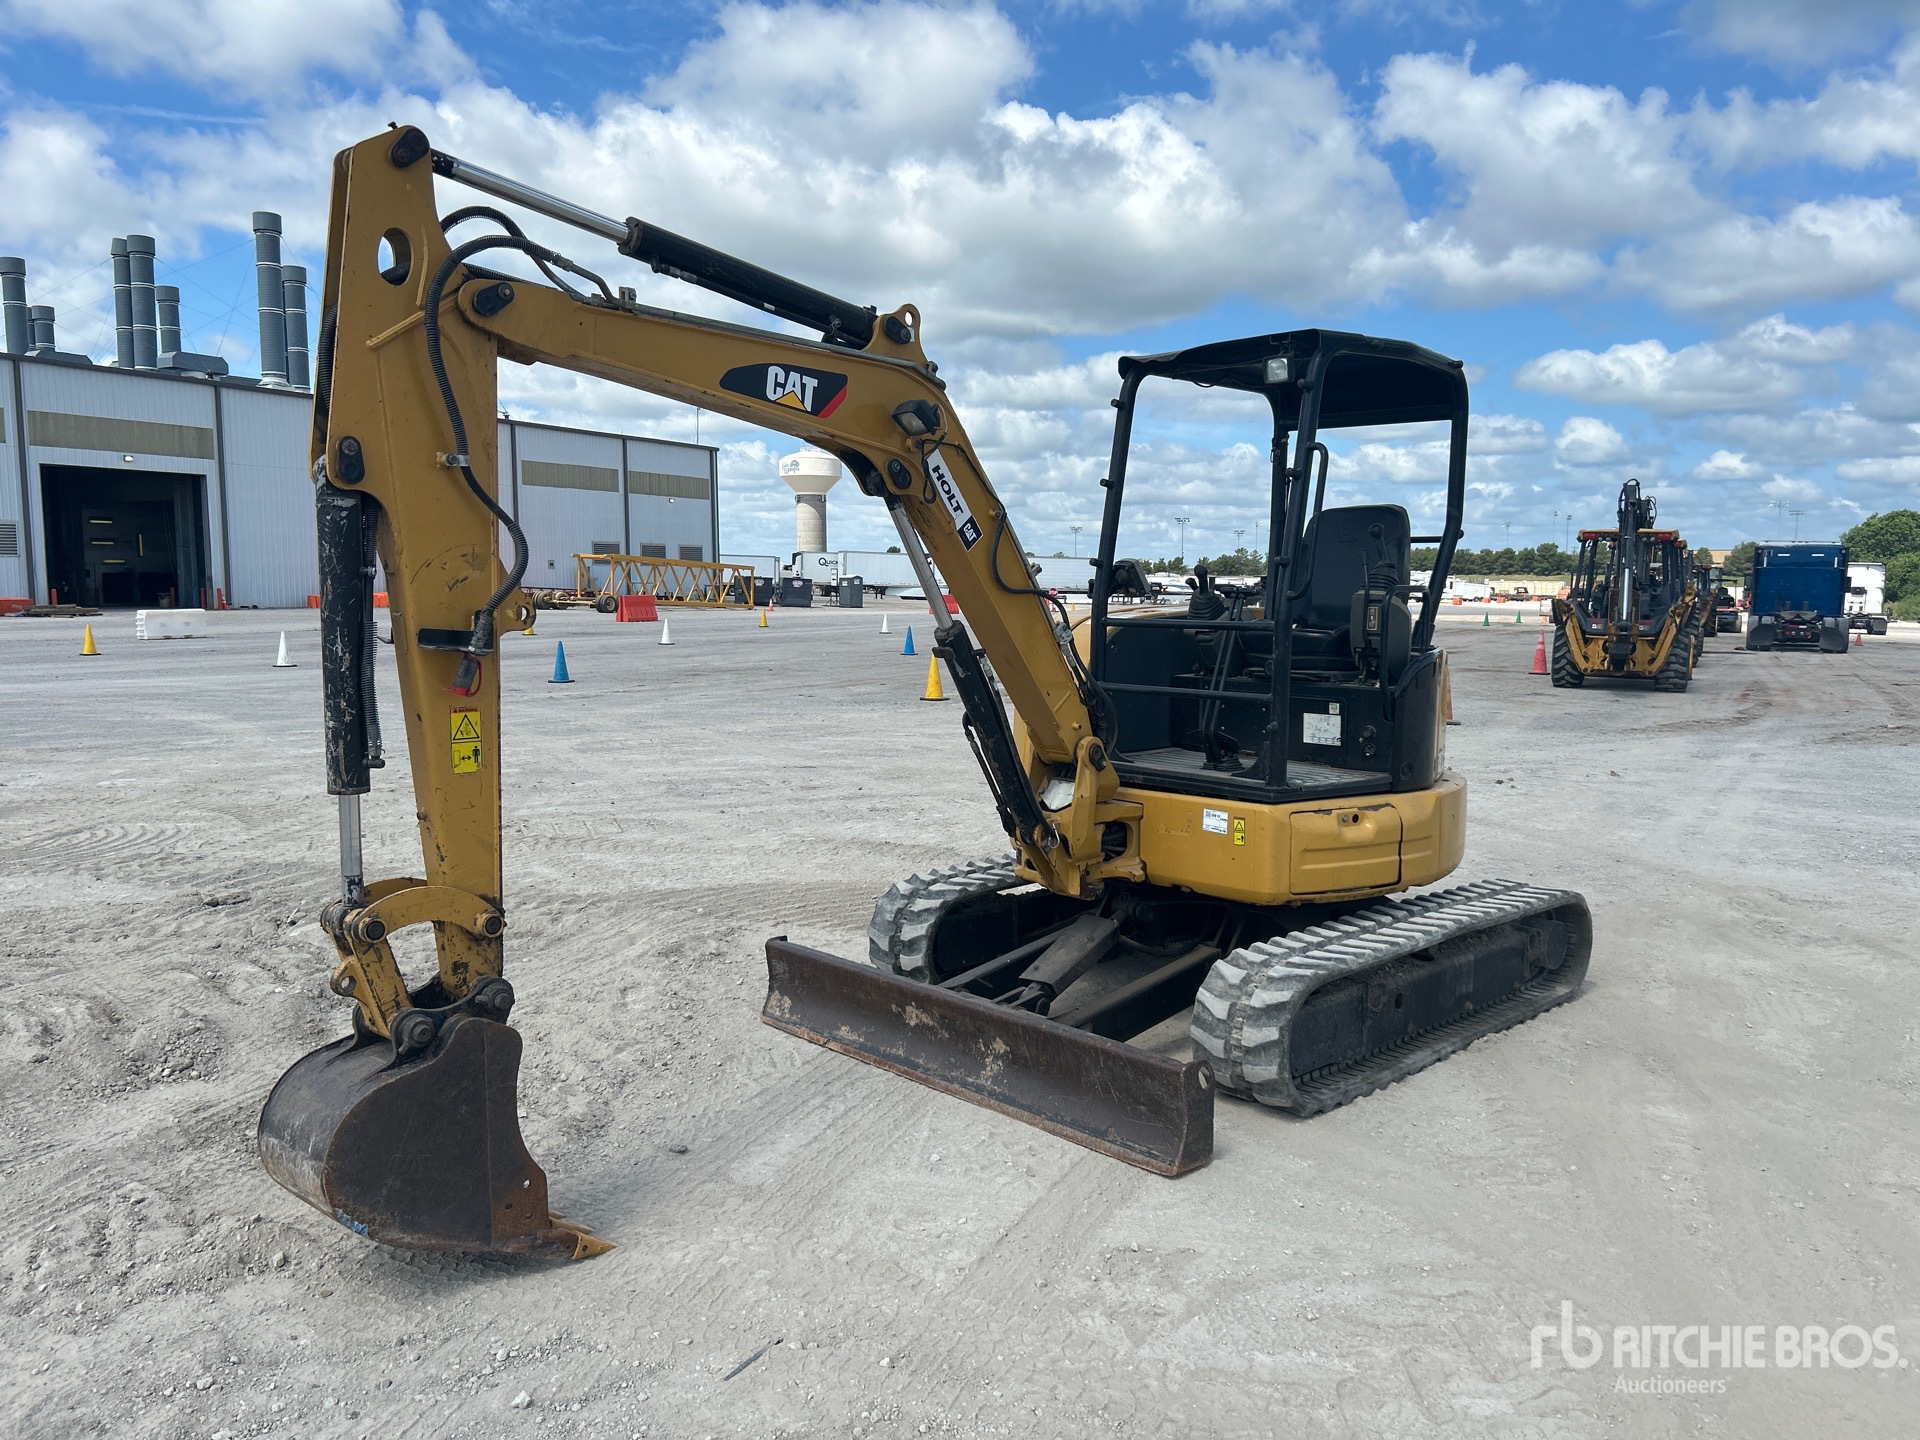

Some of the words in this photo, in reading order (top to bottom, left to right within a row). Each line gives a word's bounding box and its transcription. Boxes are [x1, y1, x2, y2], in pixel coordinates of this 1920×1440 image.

[766, 365, 818, 412] CAT
[931, 464, 964, 517] HOLT
[963, 522, 978, 542] CAT
